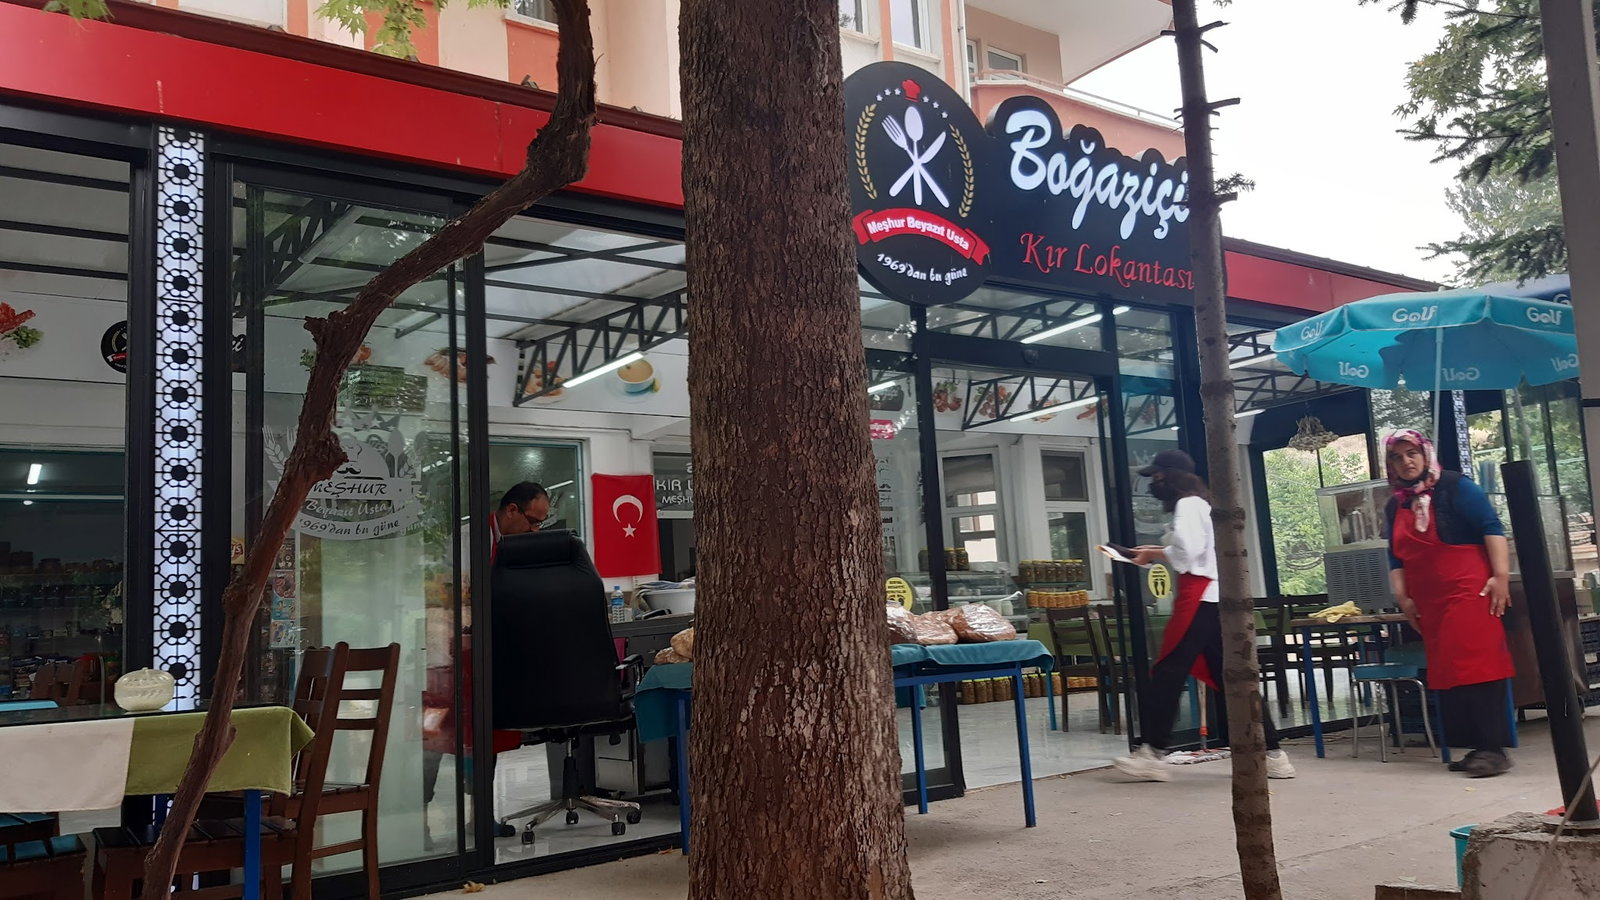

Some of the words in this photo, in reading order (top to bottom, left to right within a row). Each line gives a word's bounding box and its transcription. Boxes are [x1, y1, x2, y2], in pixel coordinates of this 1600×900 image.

[1006, 109, 1190, 240] Boğaziçi
[867, 217, 905, 235] Meşhur
[906, 216, 945, 237] Beyazıt
[946, 228, 969, 250] Usta
[877, 253, 926, 281] 1969'dan
[944, 267, 968, 286] güne
[1020, 232, 1068, 274] Kır
[1074, 243, 1194, 290] Lokantası
[1392, 305, 1438, 323] Golf
[1526, 307, 1562, 326] Golf
[1300, 320, 1324, 340] Golf
[656, 479, 682, 491] KIR
[357, 503, 388, 516] Usta
[661, 495, 694, 505] MEŞHU
[373, 520, 400, 536] güne
